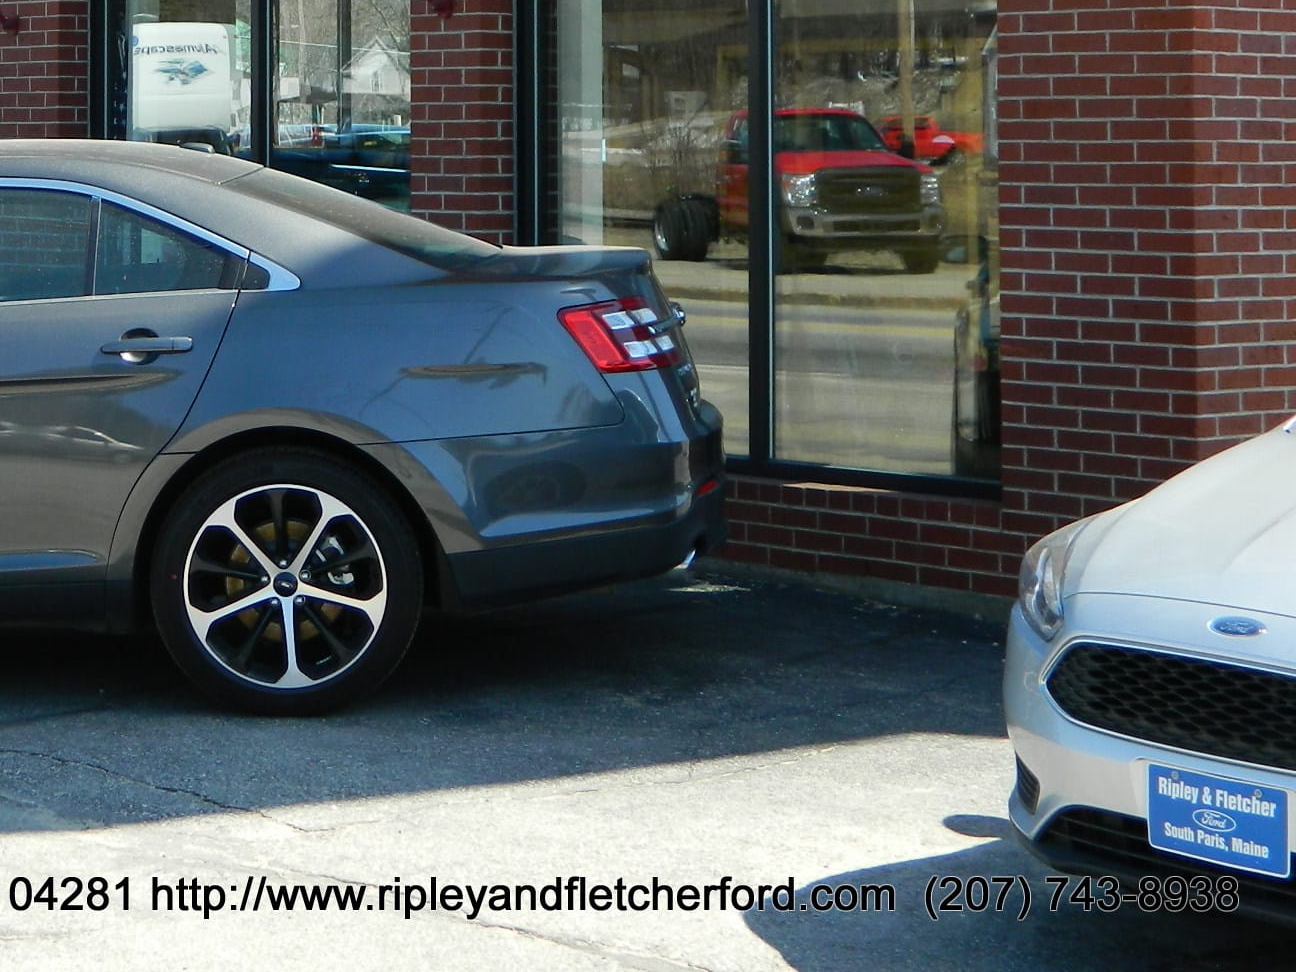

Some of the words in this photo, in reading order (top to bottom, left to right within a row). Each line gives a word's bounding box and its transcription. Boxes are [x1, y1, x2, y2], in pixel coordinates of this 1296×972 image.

[1158, 776, 1199, 804] Ripley
[1202, 786, 1213, 806] &
[1215, 788, 1277, 818] Fletcher
[1201, 812, 1226, 829] Ford
[1164, 822, 1195, 841] South
[1197, 829, 1229, 852] Paris,
[1231, 837, 1270, 859] Maine
